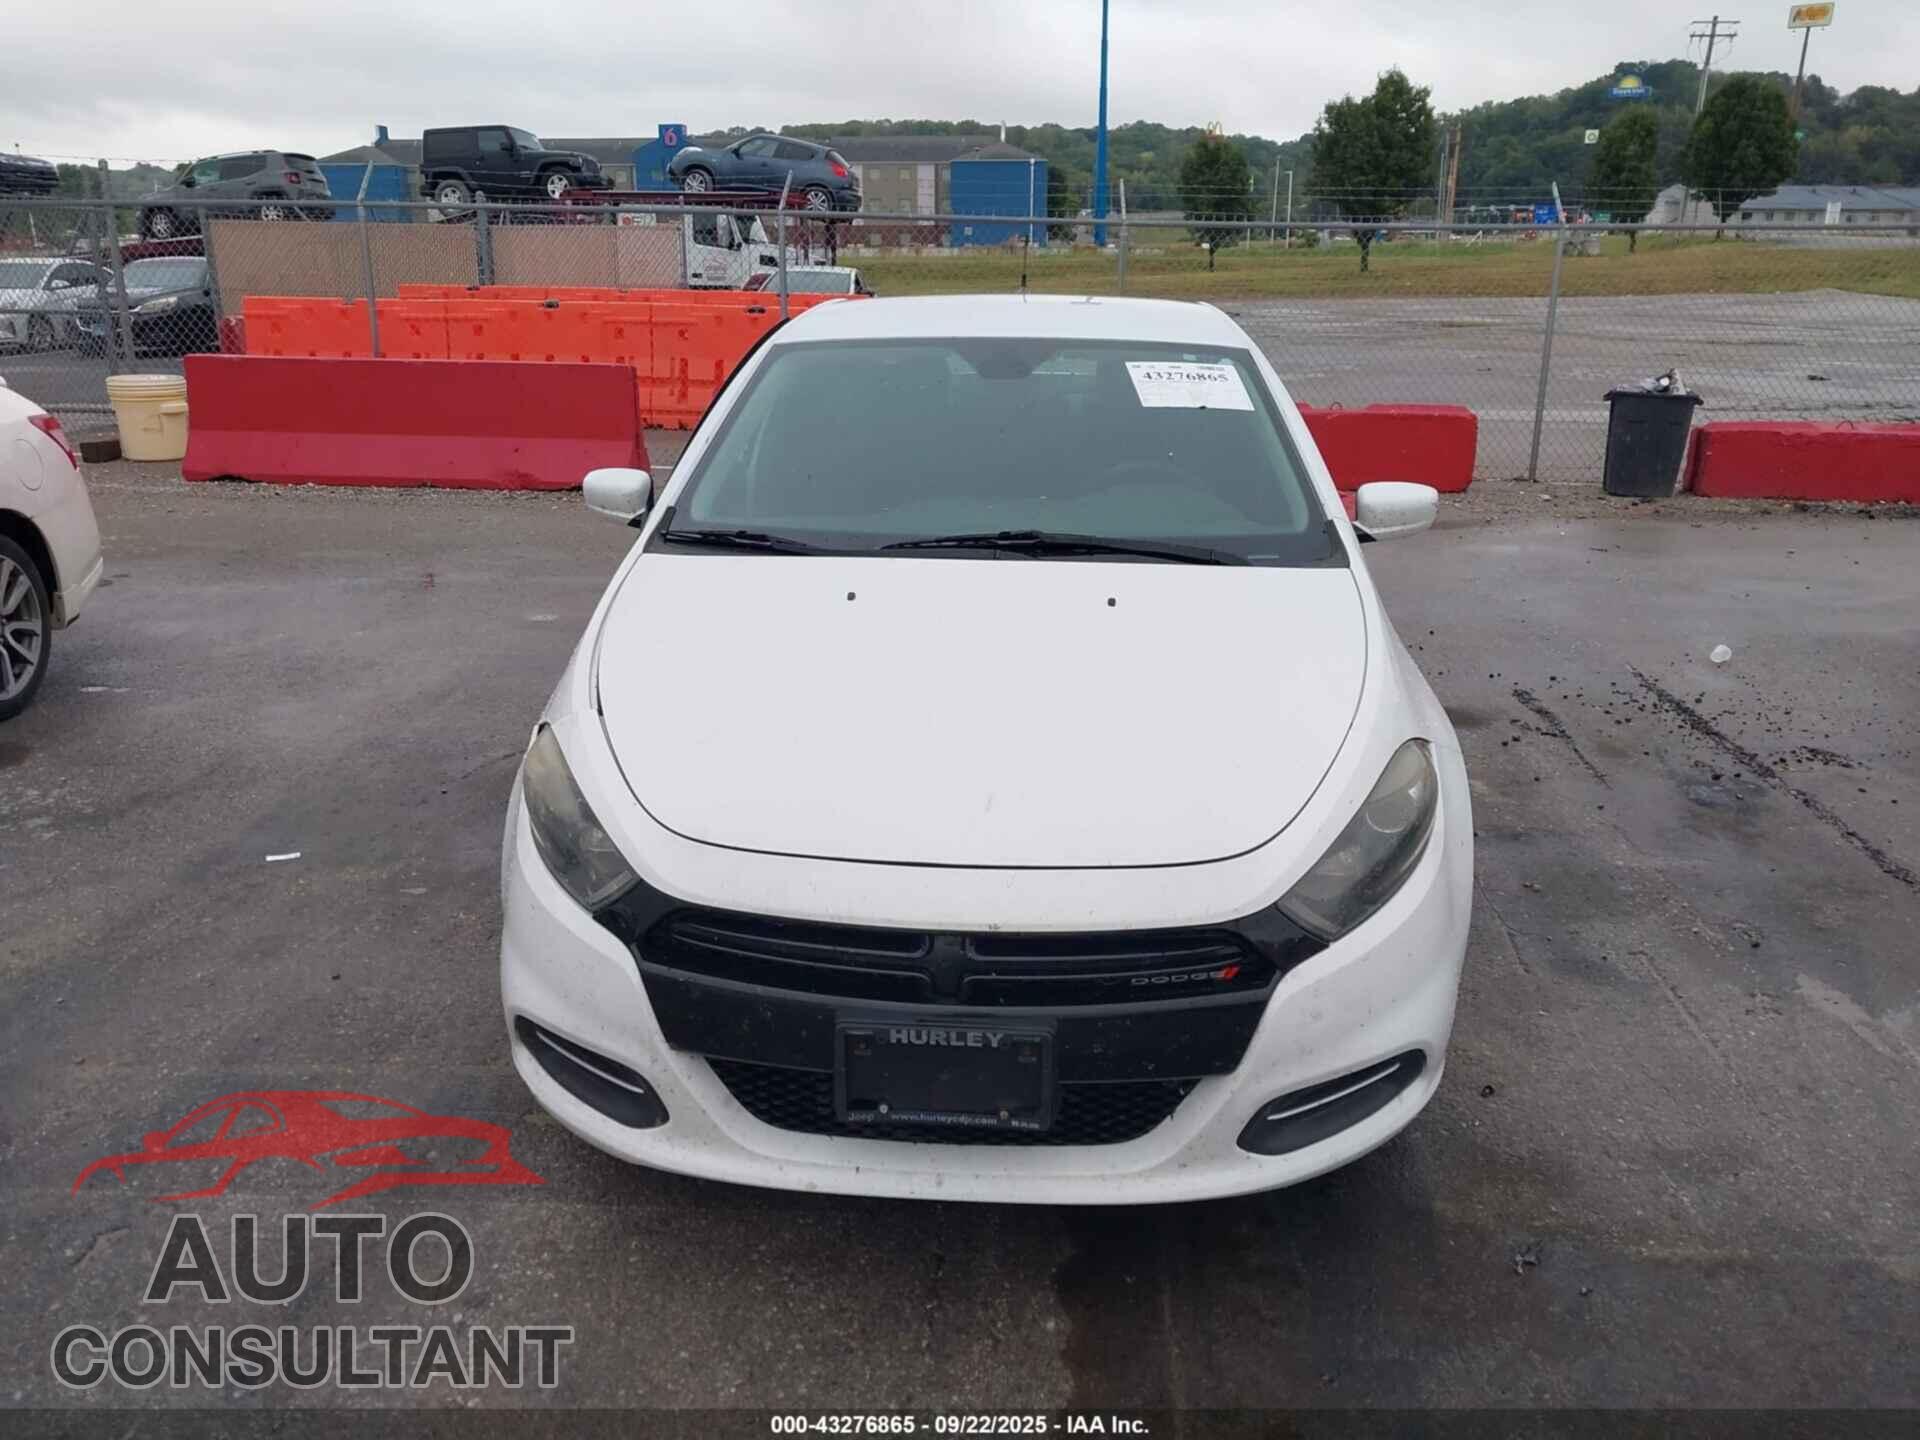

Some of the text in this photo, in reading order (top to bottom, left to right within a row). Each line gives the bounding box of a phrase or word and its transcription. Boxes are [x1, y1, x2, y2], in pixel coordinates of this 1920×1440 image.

[664, 128, 677, 147] 6
[1143, 371, 1230, 383] 43276865
[1131, 970, 1225, 985] DODGE
[889, 1028, 1003, 1048] HURLEY
